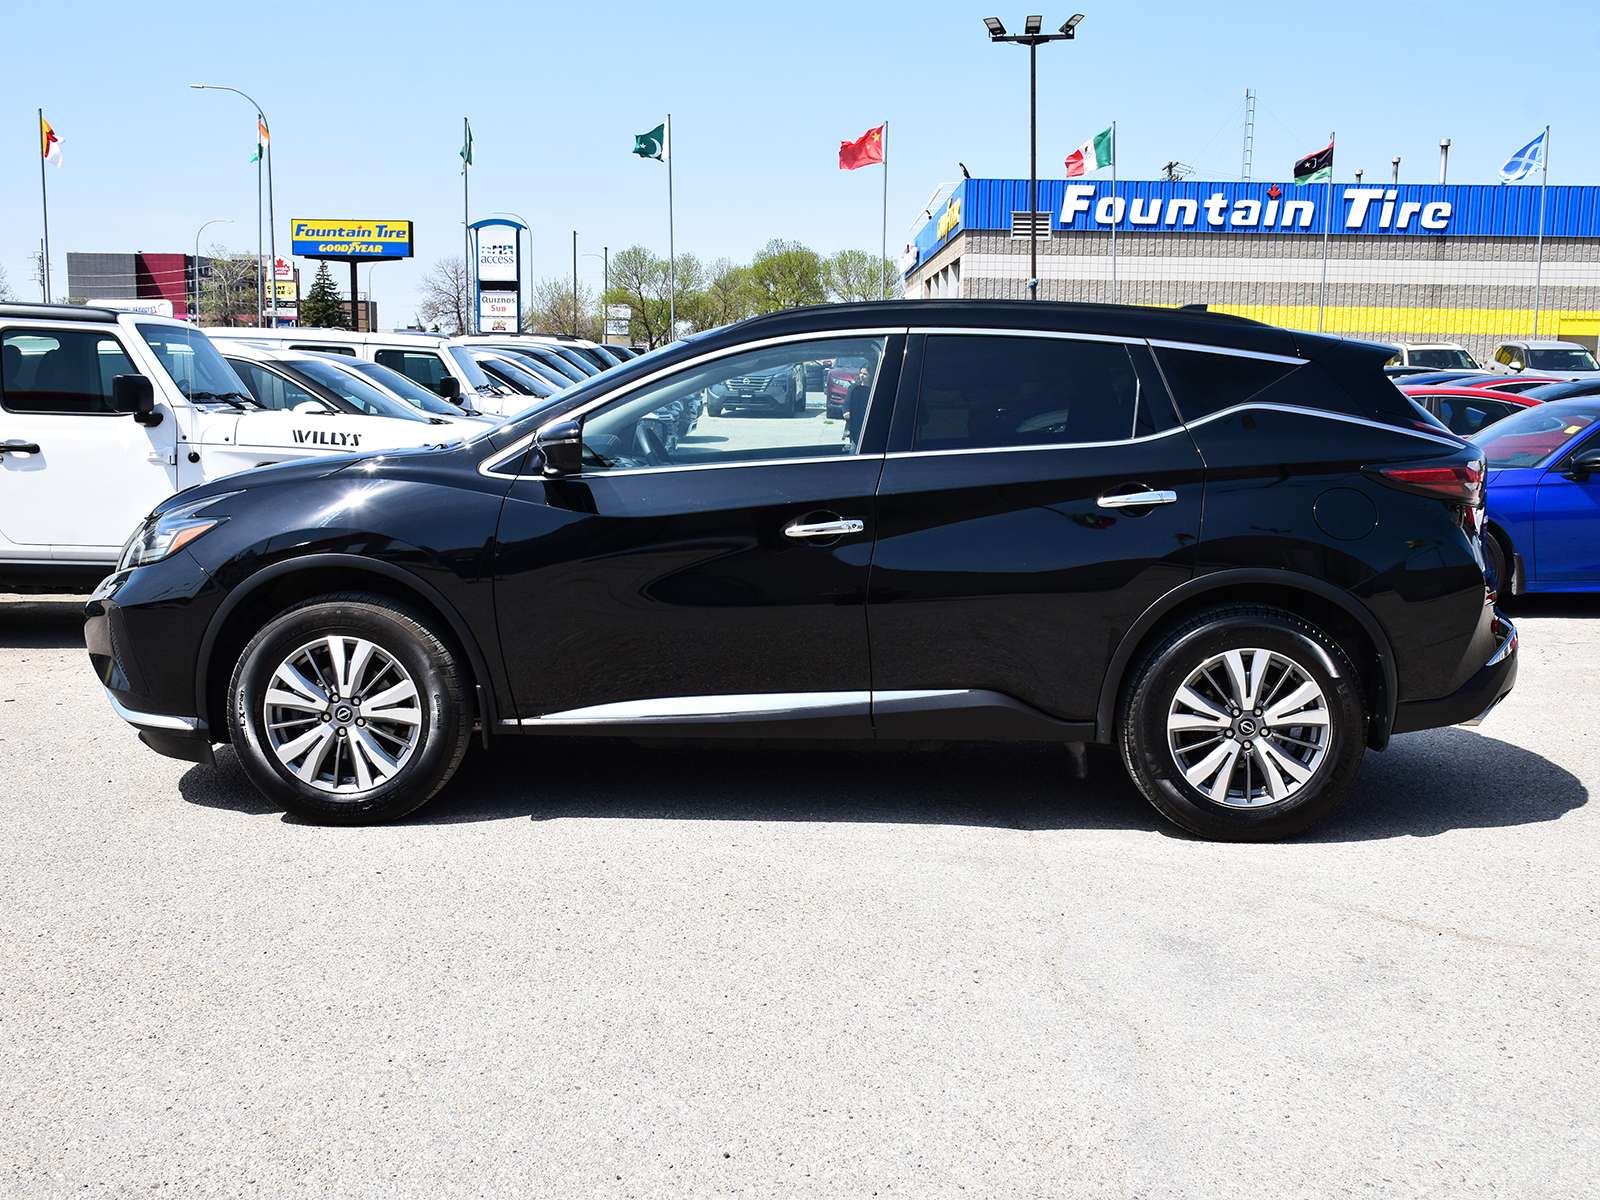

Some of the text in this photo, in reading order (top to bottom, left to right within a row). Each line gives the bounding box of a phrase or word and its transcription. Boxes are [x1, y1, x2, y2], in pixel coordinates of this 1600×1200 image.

[1060, 184, 1452, 229] Fountain Tire
[295, 223, 407, 239] Fountain Tire
[318, 241, 384, 254] GOODYEAR
[480, 255, 514, 264] access
[292, 429, 362, 447] WILLYS
[239, 711, 246, 727] LX
